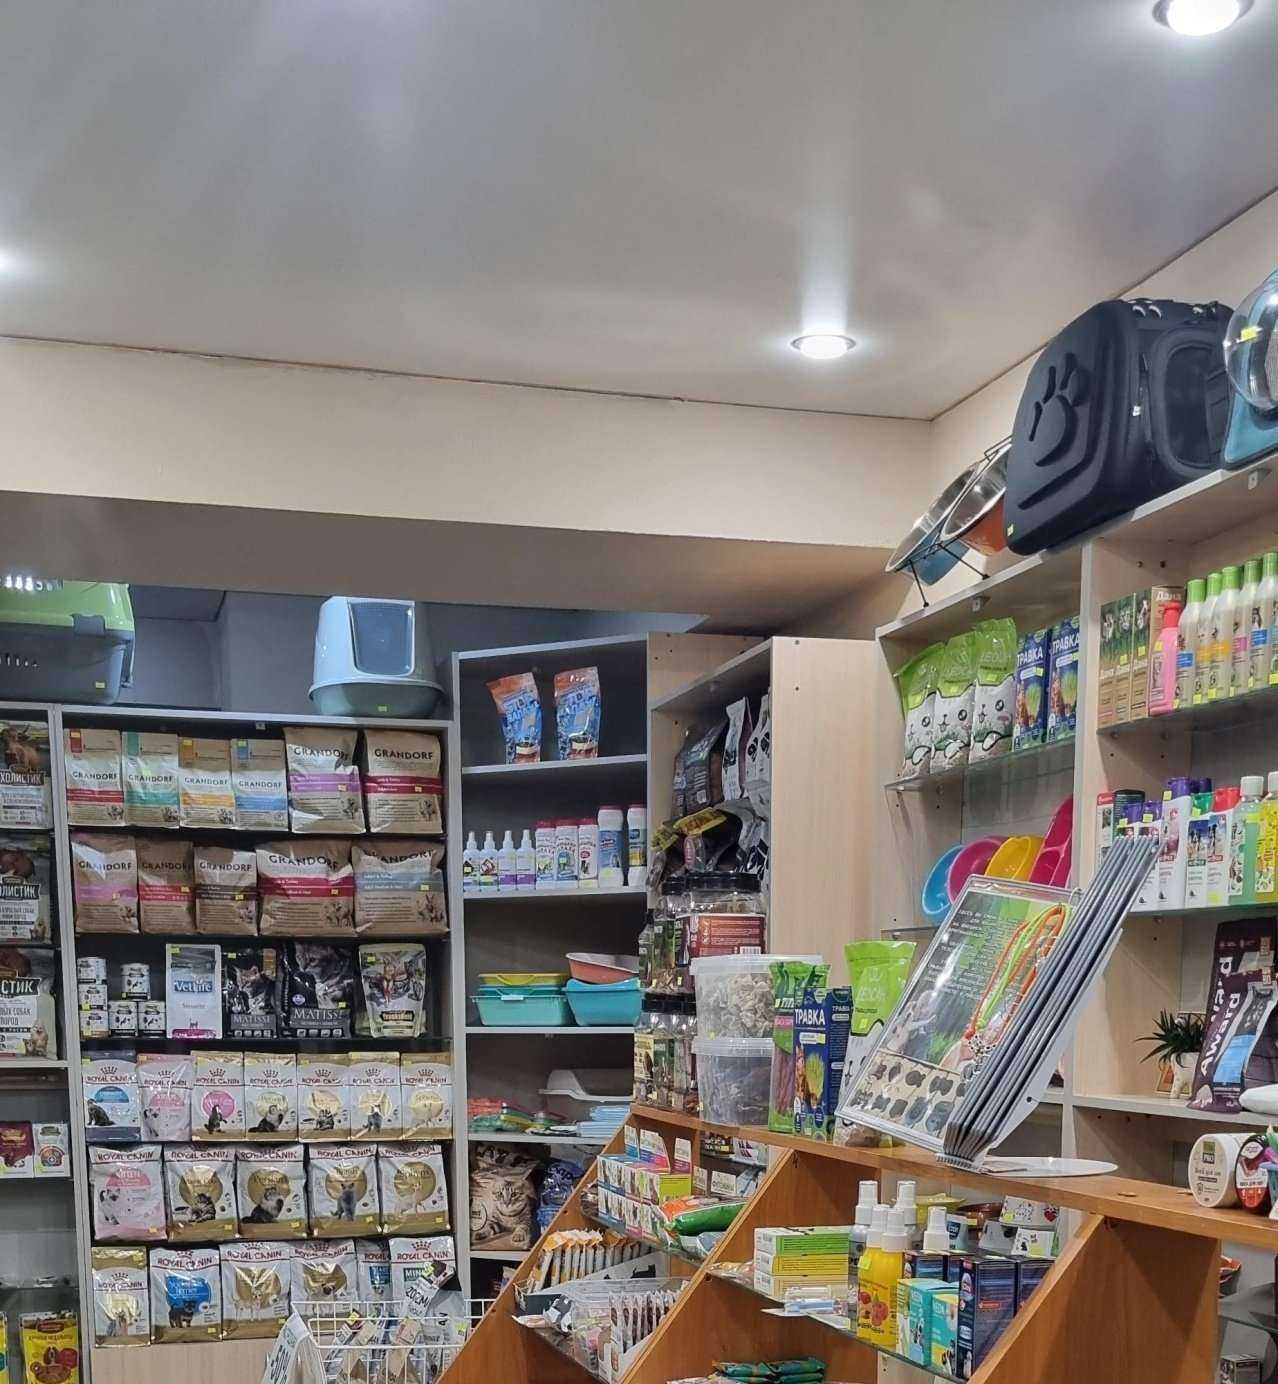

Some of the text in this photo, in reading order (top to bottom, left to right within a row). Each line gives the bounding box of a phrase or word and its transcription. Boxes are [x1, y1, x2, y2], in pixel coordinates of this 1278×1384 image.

[1017, 646, 1044, 665] ТРАВКА
[374, 748, 433, 760] GRANDORF
[72, 770, 118, 782] GRANDORF
[184, 777, 228, 786] GRANDORF
[238, 779, 283, 789] GRANDORF
[200, 862, 252, 873] GRANDORF
[1, 979, 34, 994] СТИК
[795, 1008, 826, 1025] ТРАВКА
[1200, 992, 1242, 1077] Award
[254, 1250, 282, 1260] CANIN
[364, 1252, 386, 1261] ROYAL
[397, 1251, 449, 1261] ROYAL CANIN
[158, 1257, 184, 1267] ROYAL
